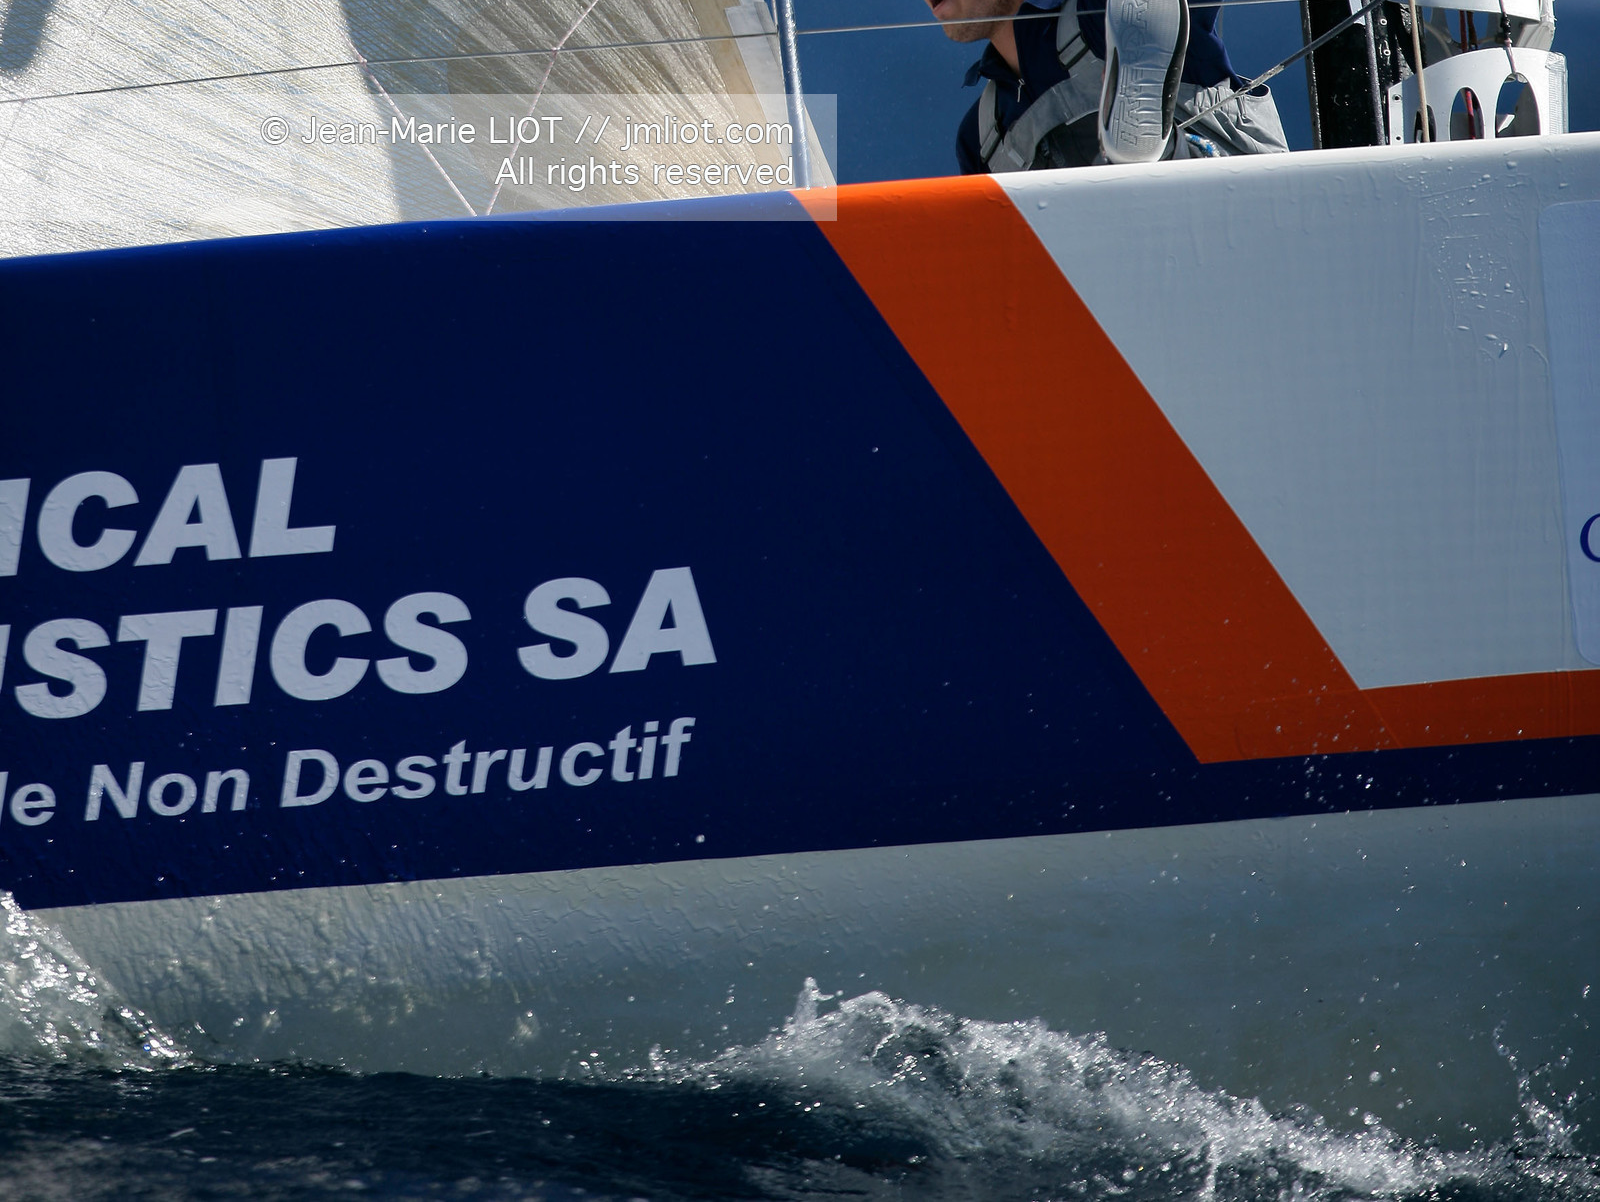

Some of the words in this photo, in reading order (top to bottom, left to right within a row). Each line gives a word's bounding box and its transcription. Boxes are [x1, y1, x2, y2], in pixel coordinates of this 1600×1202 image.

[0, 592, 472, 718] STICS
[518, 566, 718, 680] SA
[85, 762, 250, 822] Non
[281, 717, 697, 808] Destructif
